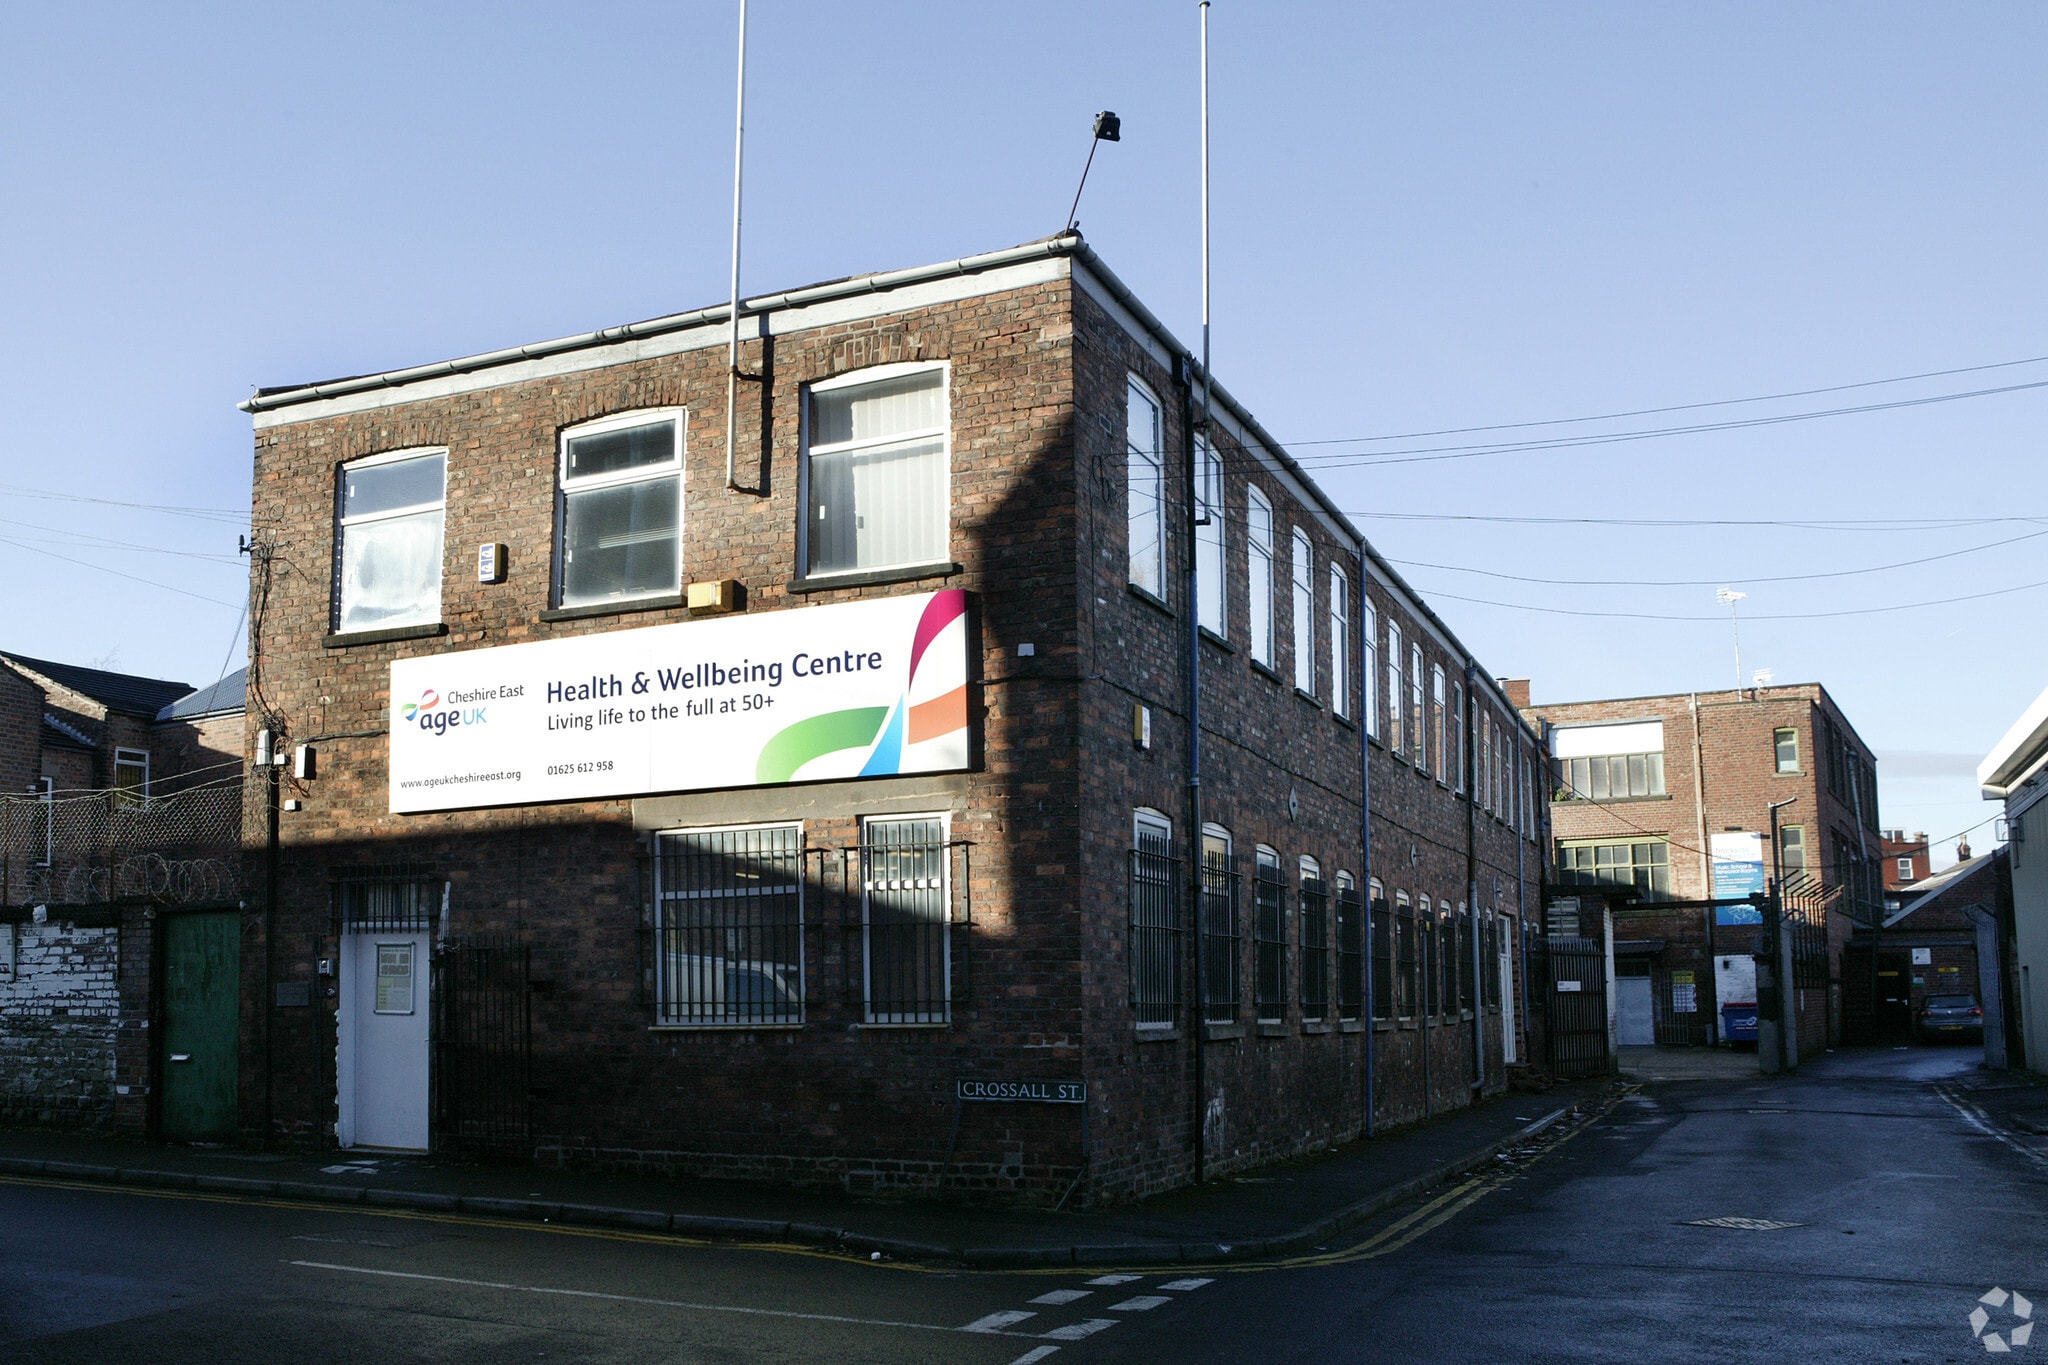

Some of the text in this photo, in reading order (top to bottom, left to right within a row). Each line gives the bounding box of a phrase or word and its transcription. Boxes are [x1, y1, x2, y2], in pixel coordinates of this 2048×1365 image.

[548, 650, 882, 703] Health & Wellbeing Centre
[448, 685, 524, 704] Cheshire East
[548, 694, 774, 730] Living life to the full at 50+
[547, 761, 614, 775] 01625 612 958
[401, 771, 521, 788] www.ageukcheshireeast.org
[963, 1082, 1082, 1099] CROSSALL ST.
